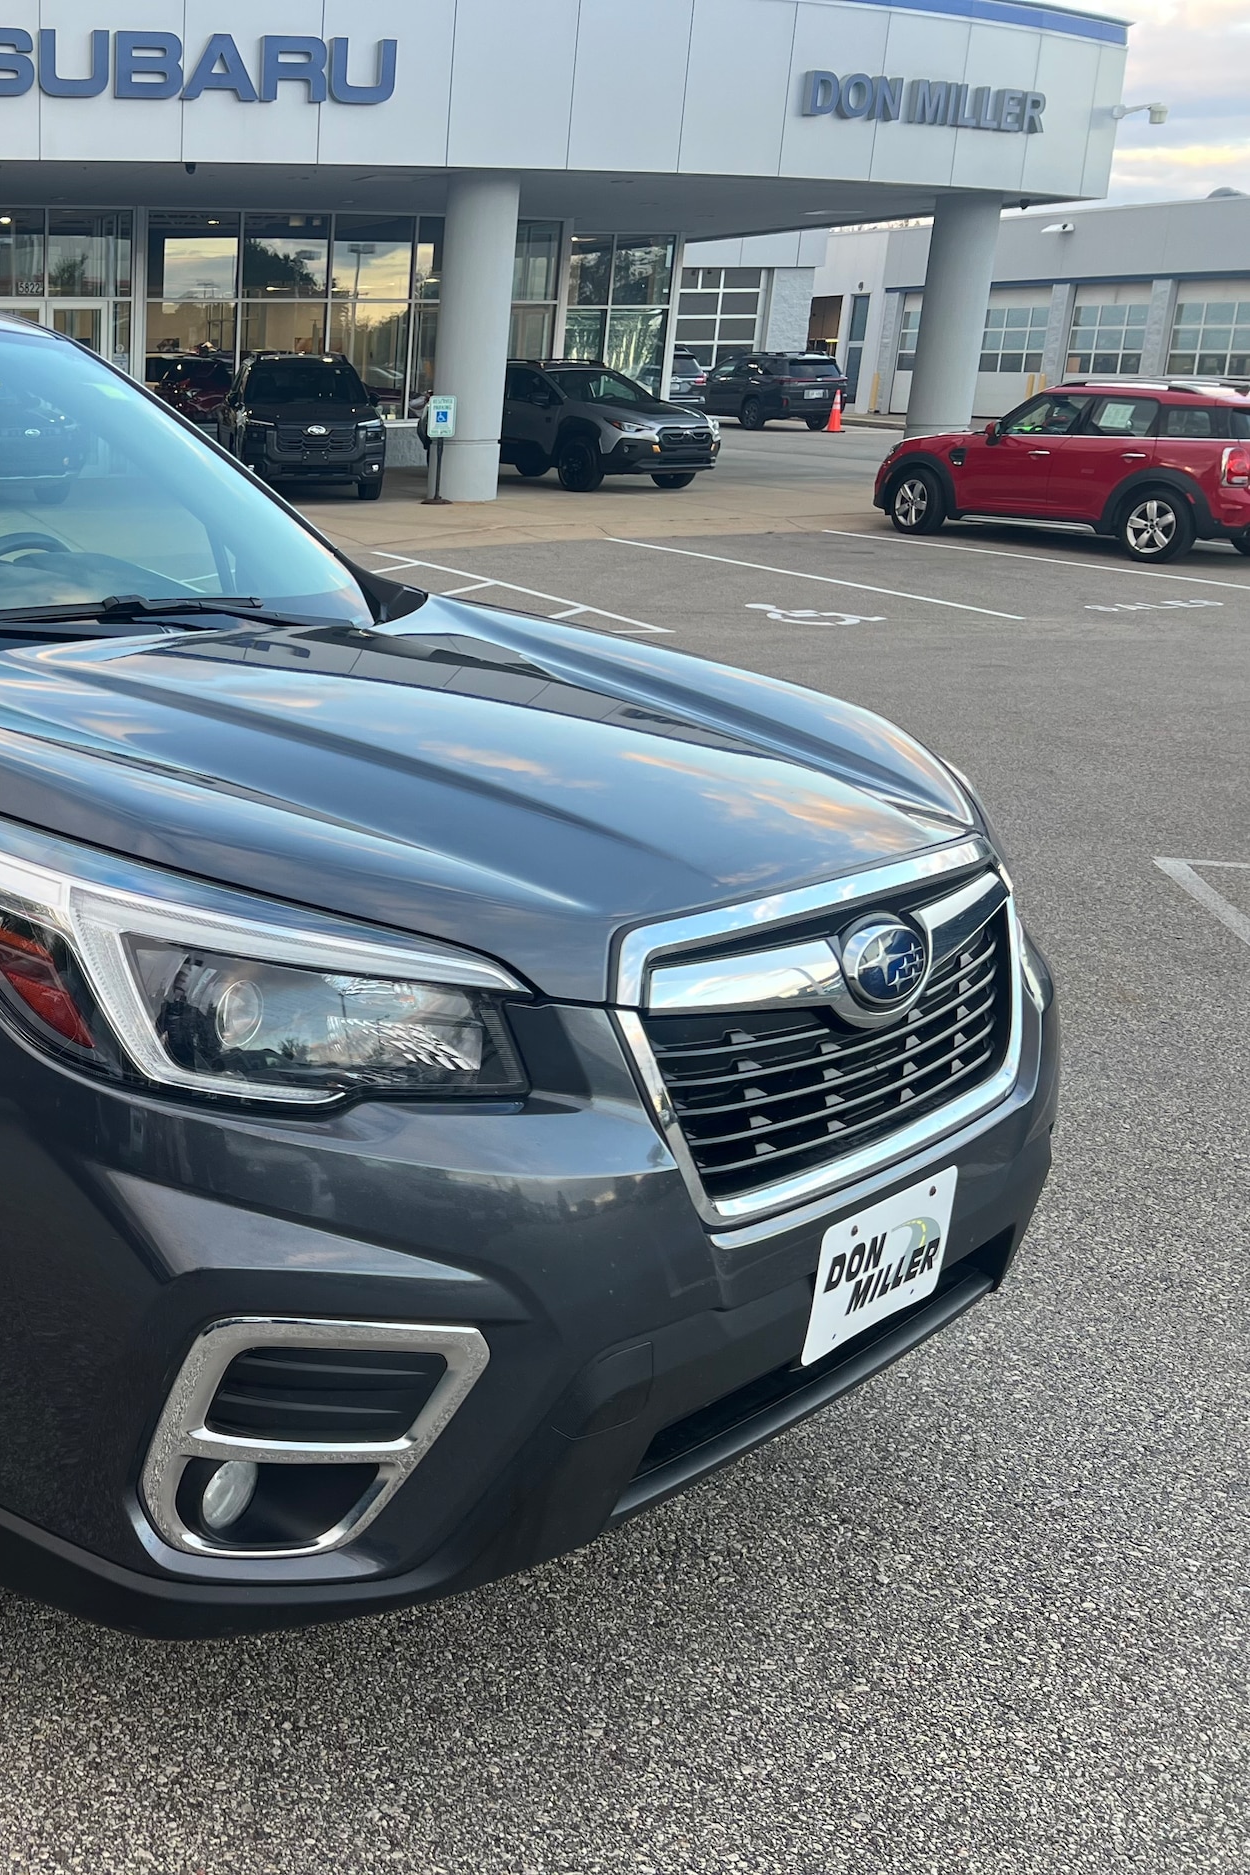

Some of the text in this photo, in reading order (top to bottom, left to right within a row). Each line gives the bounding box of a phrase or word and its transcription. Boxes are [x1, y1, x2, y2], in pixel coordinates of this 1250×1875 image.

[802, 70, 1047, 134] DON MILLER
[19, 282, 40, 294] 5822
[823, 1231, 887, 1294] DON
[844, 1237, 941, 1316] MILLER
